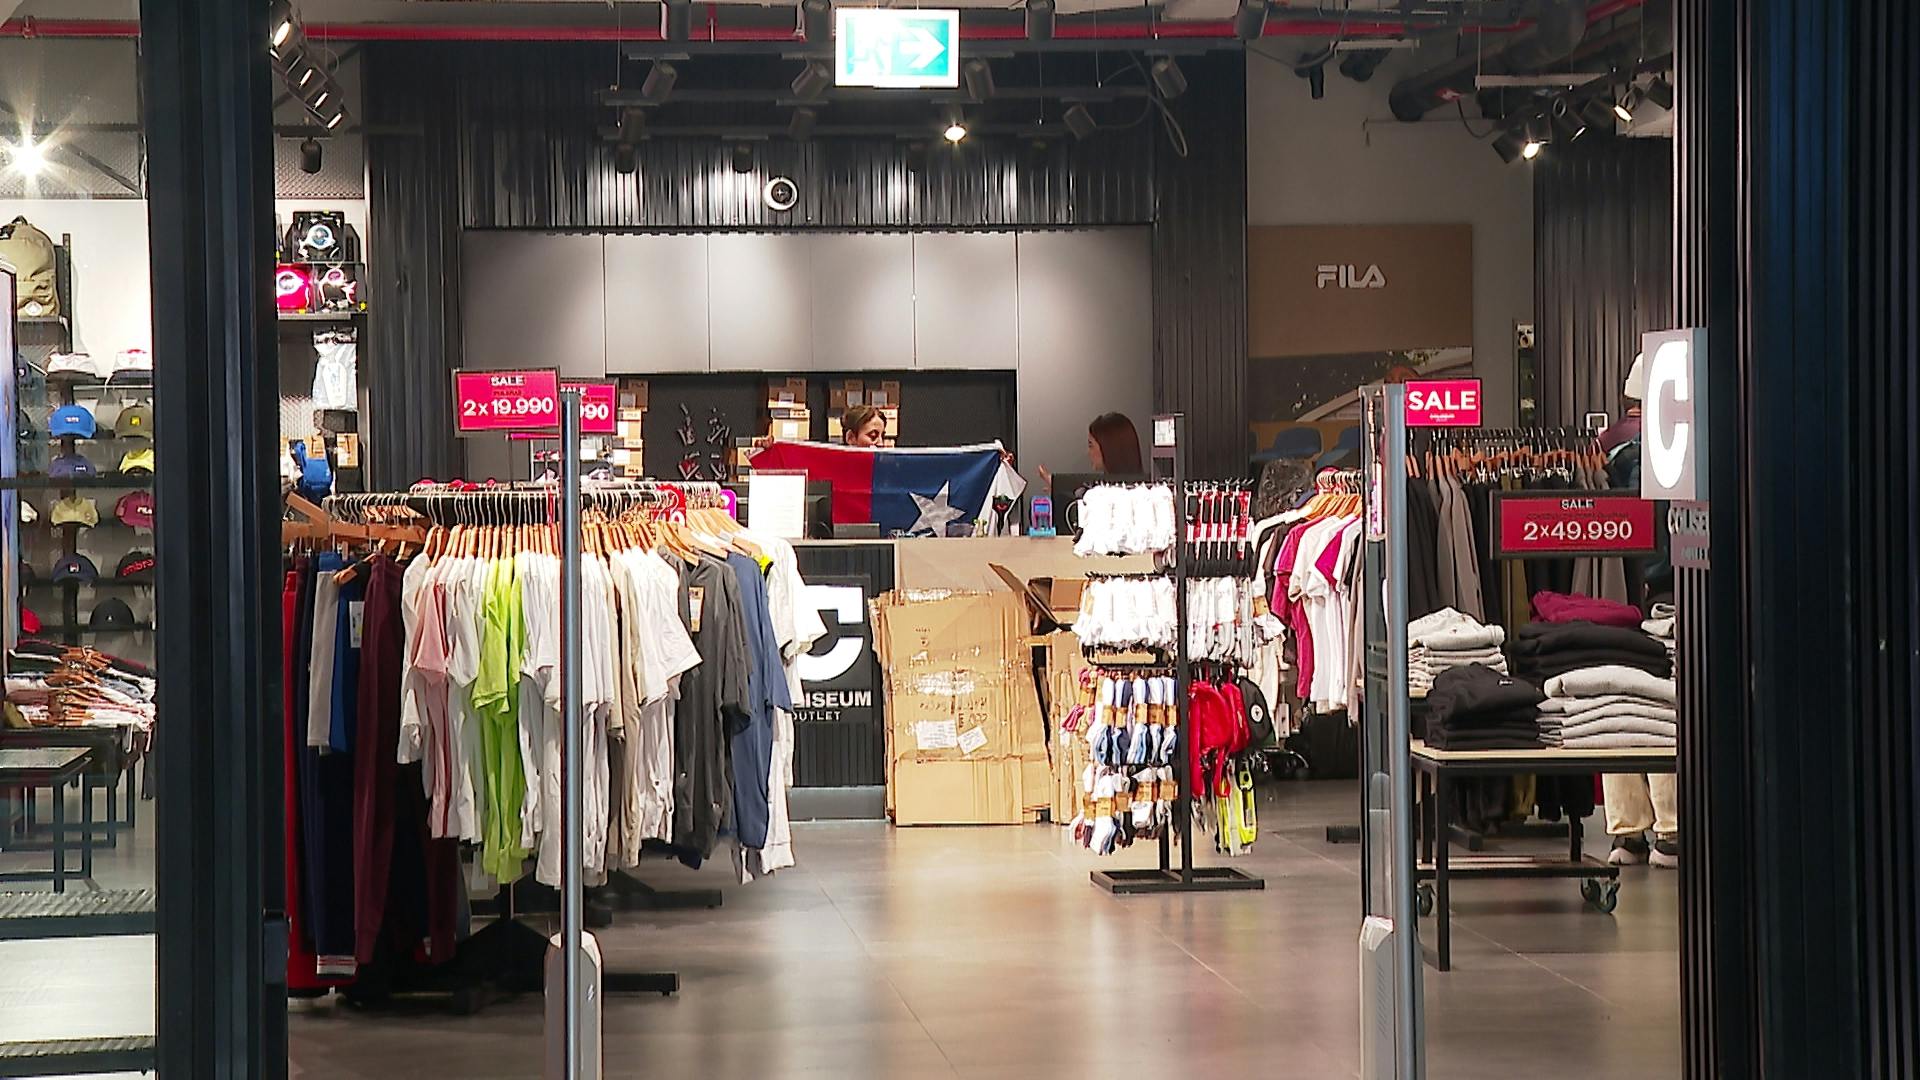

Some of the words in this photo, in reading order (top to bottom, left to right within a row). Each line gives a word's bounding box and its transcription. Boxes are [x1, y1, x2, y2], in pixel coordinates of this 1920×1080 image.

[1316, 264, 1386, 289] FILA
[490, 375, 525, 387] SALE
[1408, 390, 1477, 411] SALE
[1647, 340, 1689, 489] C
[1561, 498, 1594, 510] SALE
[794, 690, 872, 709] ISEUM
